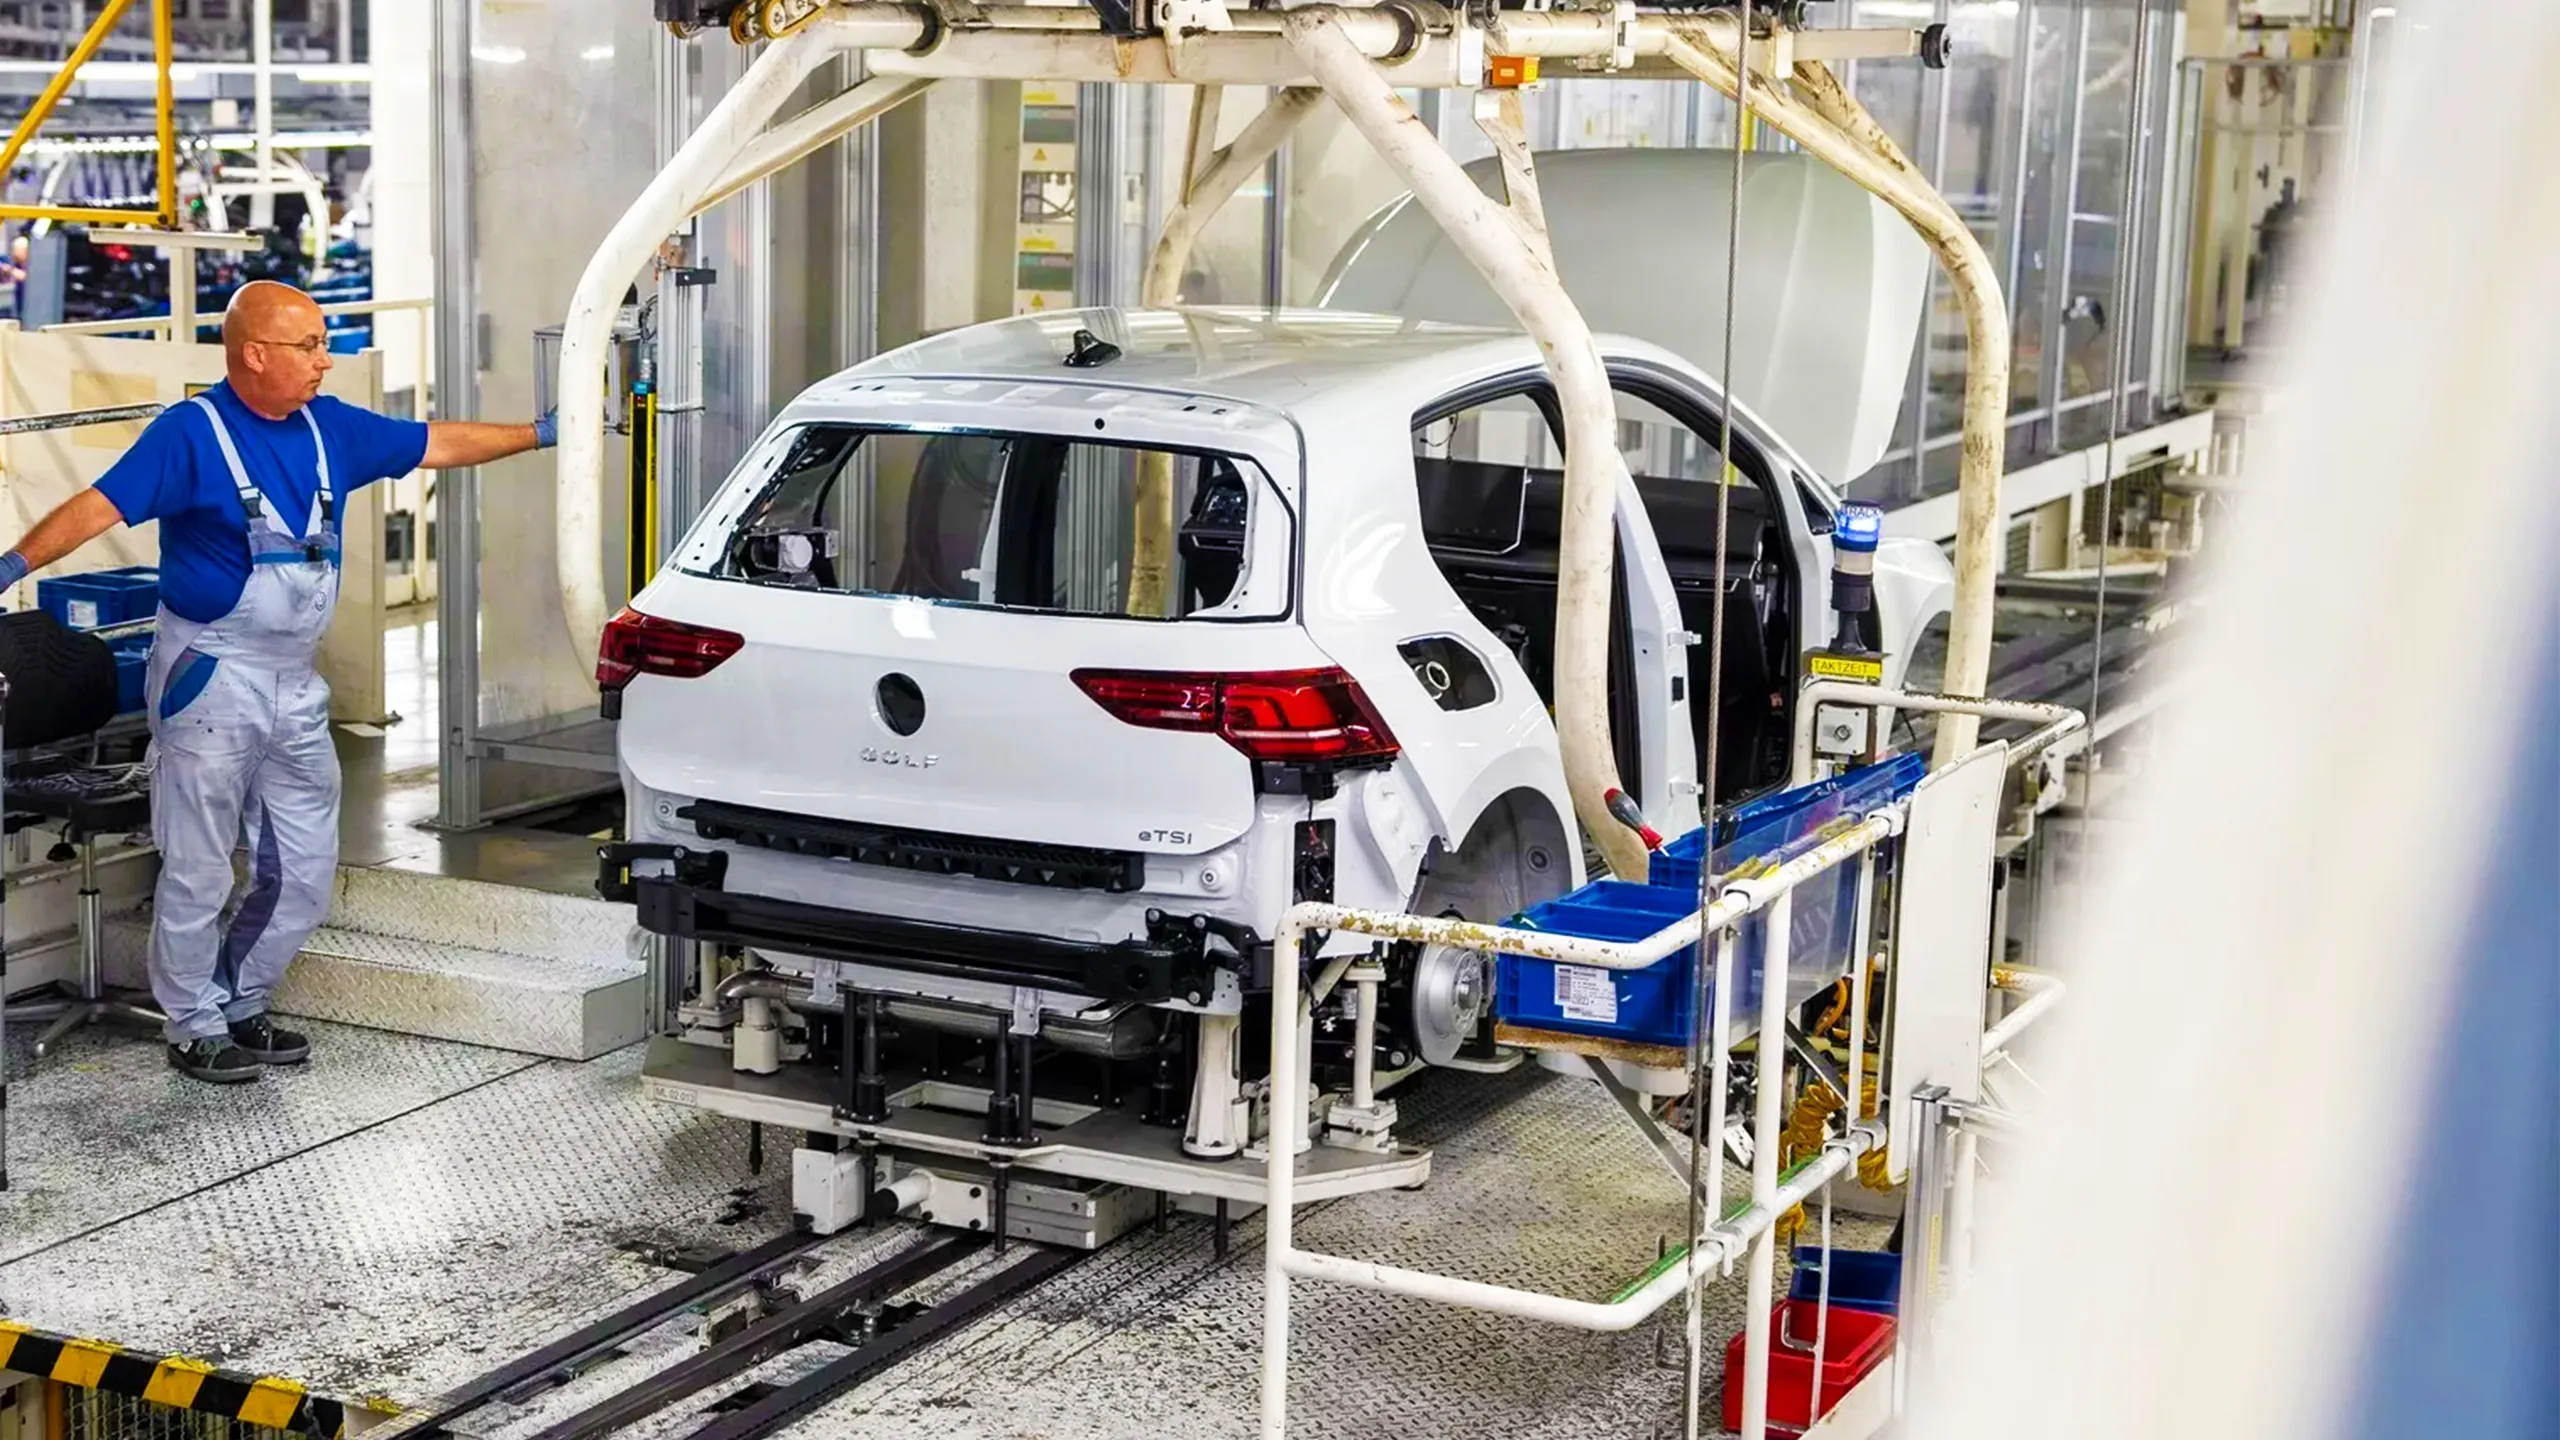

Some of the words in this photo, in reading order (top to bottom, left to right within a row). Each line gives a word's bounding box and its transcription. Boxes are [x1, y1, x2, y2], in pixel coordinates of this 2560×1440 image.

[1813, 659, 1869, 674] TAKTZEIT
[860, 747, 940, 769] GOLF
[1138, 829, 1192, 845] eTSI
